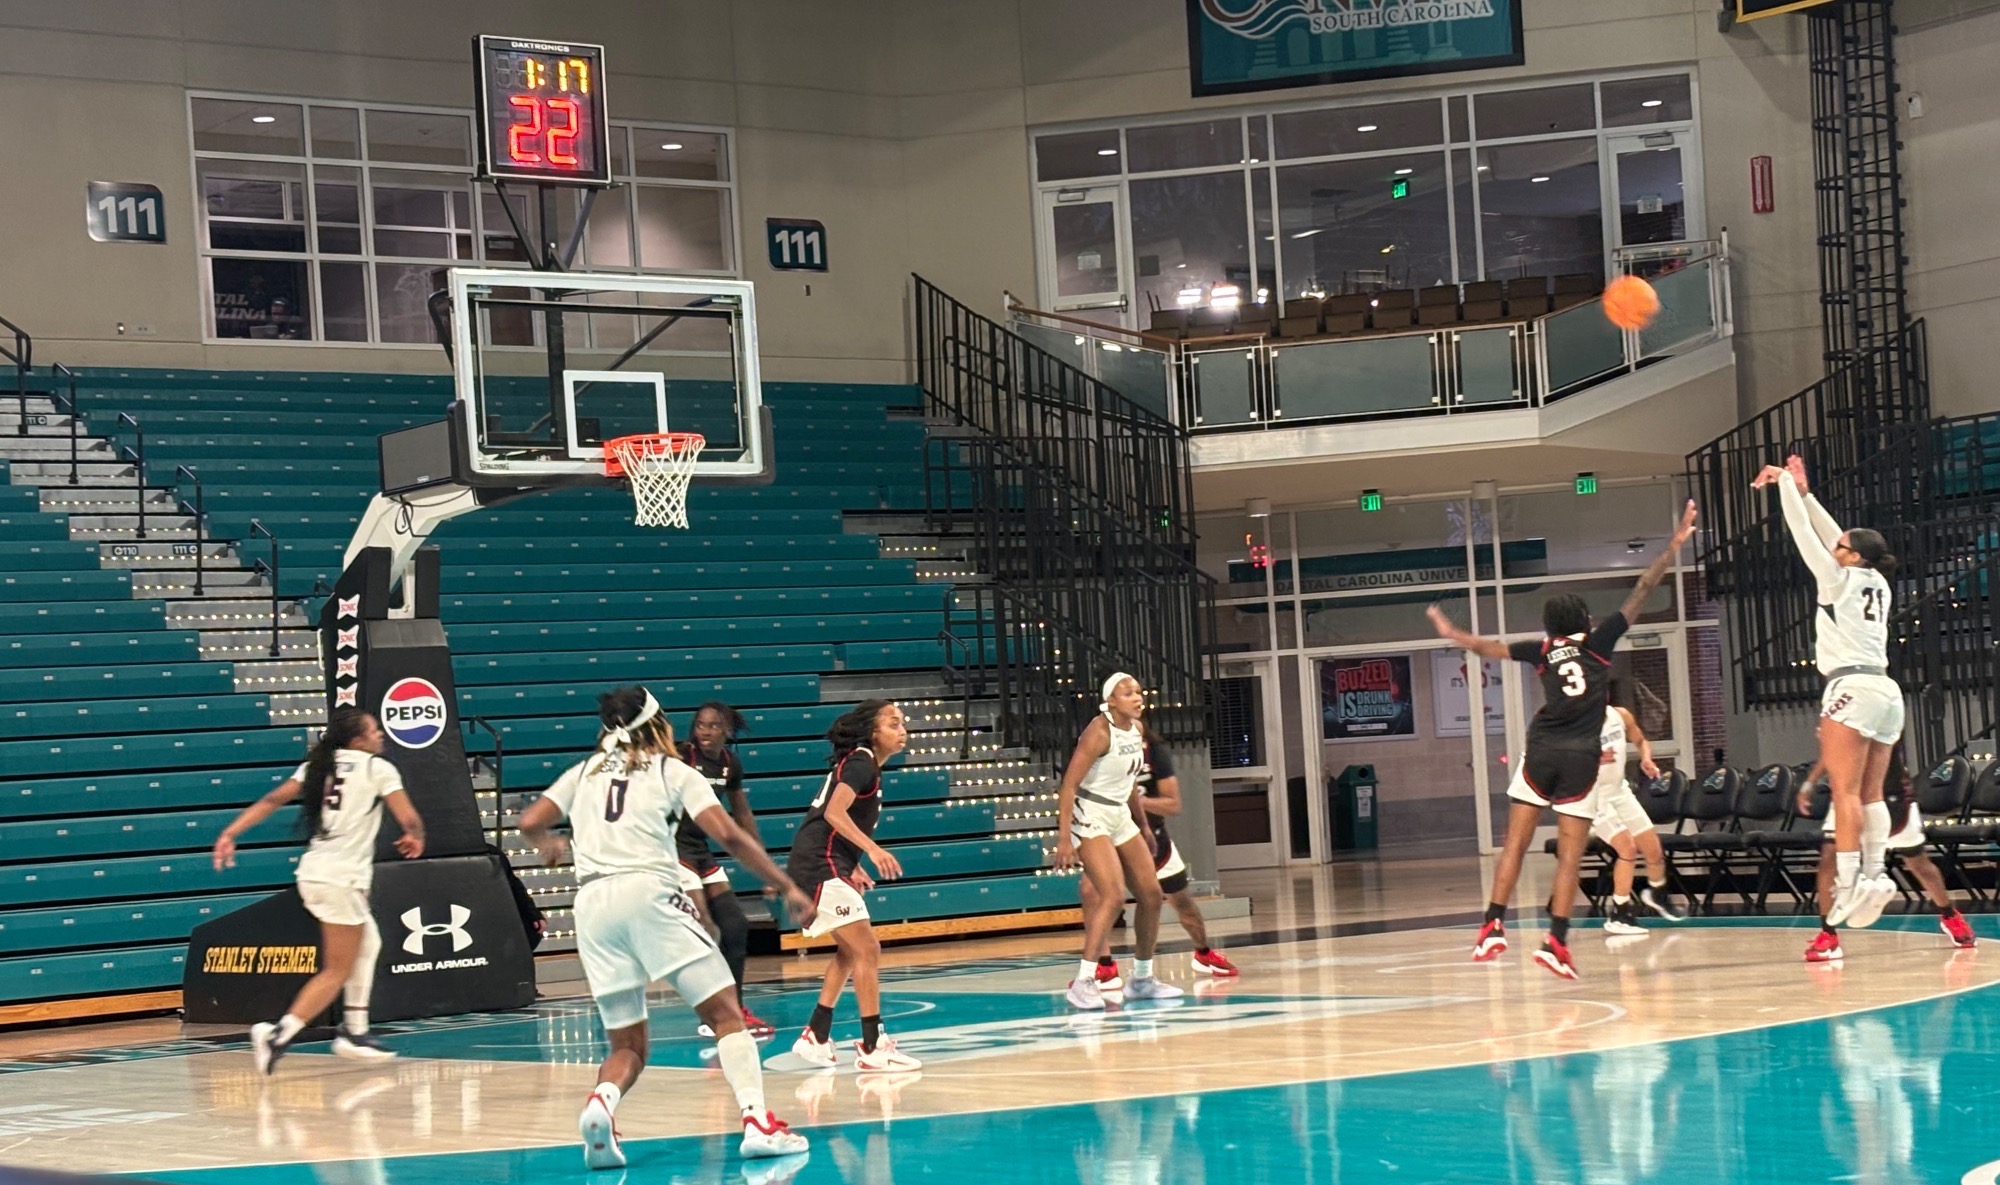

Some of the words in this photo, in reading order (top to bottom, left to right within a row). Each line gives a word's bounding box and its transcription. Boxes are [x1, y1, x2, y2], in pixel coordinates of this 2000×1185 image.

[1312, 11, 1381, 31] SOUTH
[1387, 1, 1491, 24] CAROLINA
[510, 41, 570, 53] DAKTRONICS
[526, 57, 588, 94] 1:17
[509, 95, 578, 165] 22
[98, 195, 158, 235] 111
[775, 230, 821, 264] 111
[215, 293, 248, 305] TAL
[216, 307, 266, 319] LINA
[1576, 477, 1597, 495] EXIT
[1361, 494, 1381, 511] EXIT
[174, 545, 188, 555] 111
[1337, 572, 1414, 588] CAROLINA
[1861, 587, 1884, 623] 21
[1338, 661, 1390, 690] BUZZED
[1558, 661, 1587, 697] 3
[1340, 692, 1357, 717] IS
[1357, 690, 1392, 704] DRUNK
[385, 704, 443, 721] PEPSI
[1357, 704, 1393, 717] DRIVING
[604, 778, 629, 823] 0
[835, 905, 851, 918] GW
[203, 946, 258, 973] STANLEY
[256, 945, 317, 974] STEEMER
[391, 961, 433, 974] UNDER
[435, 956, 488, 971] ARMOUR
